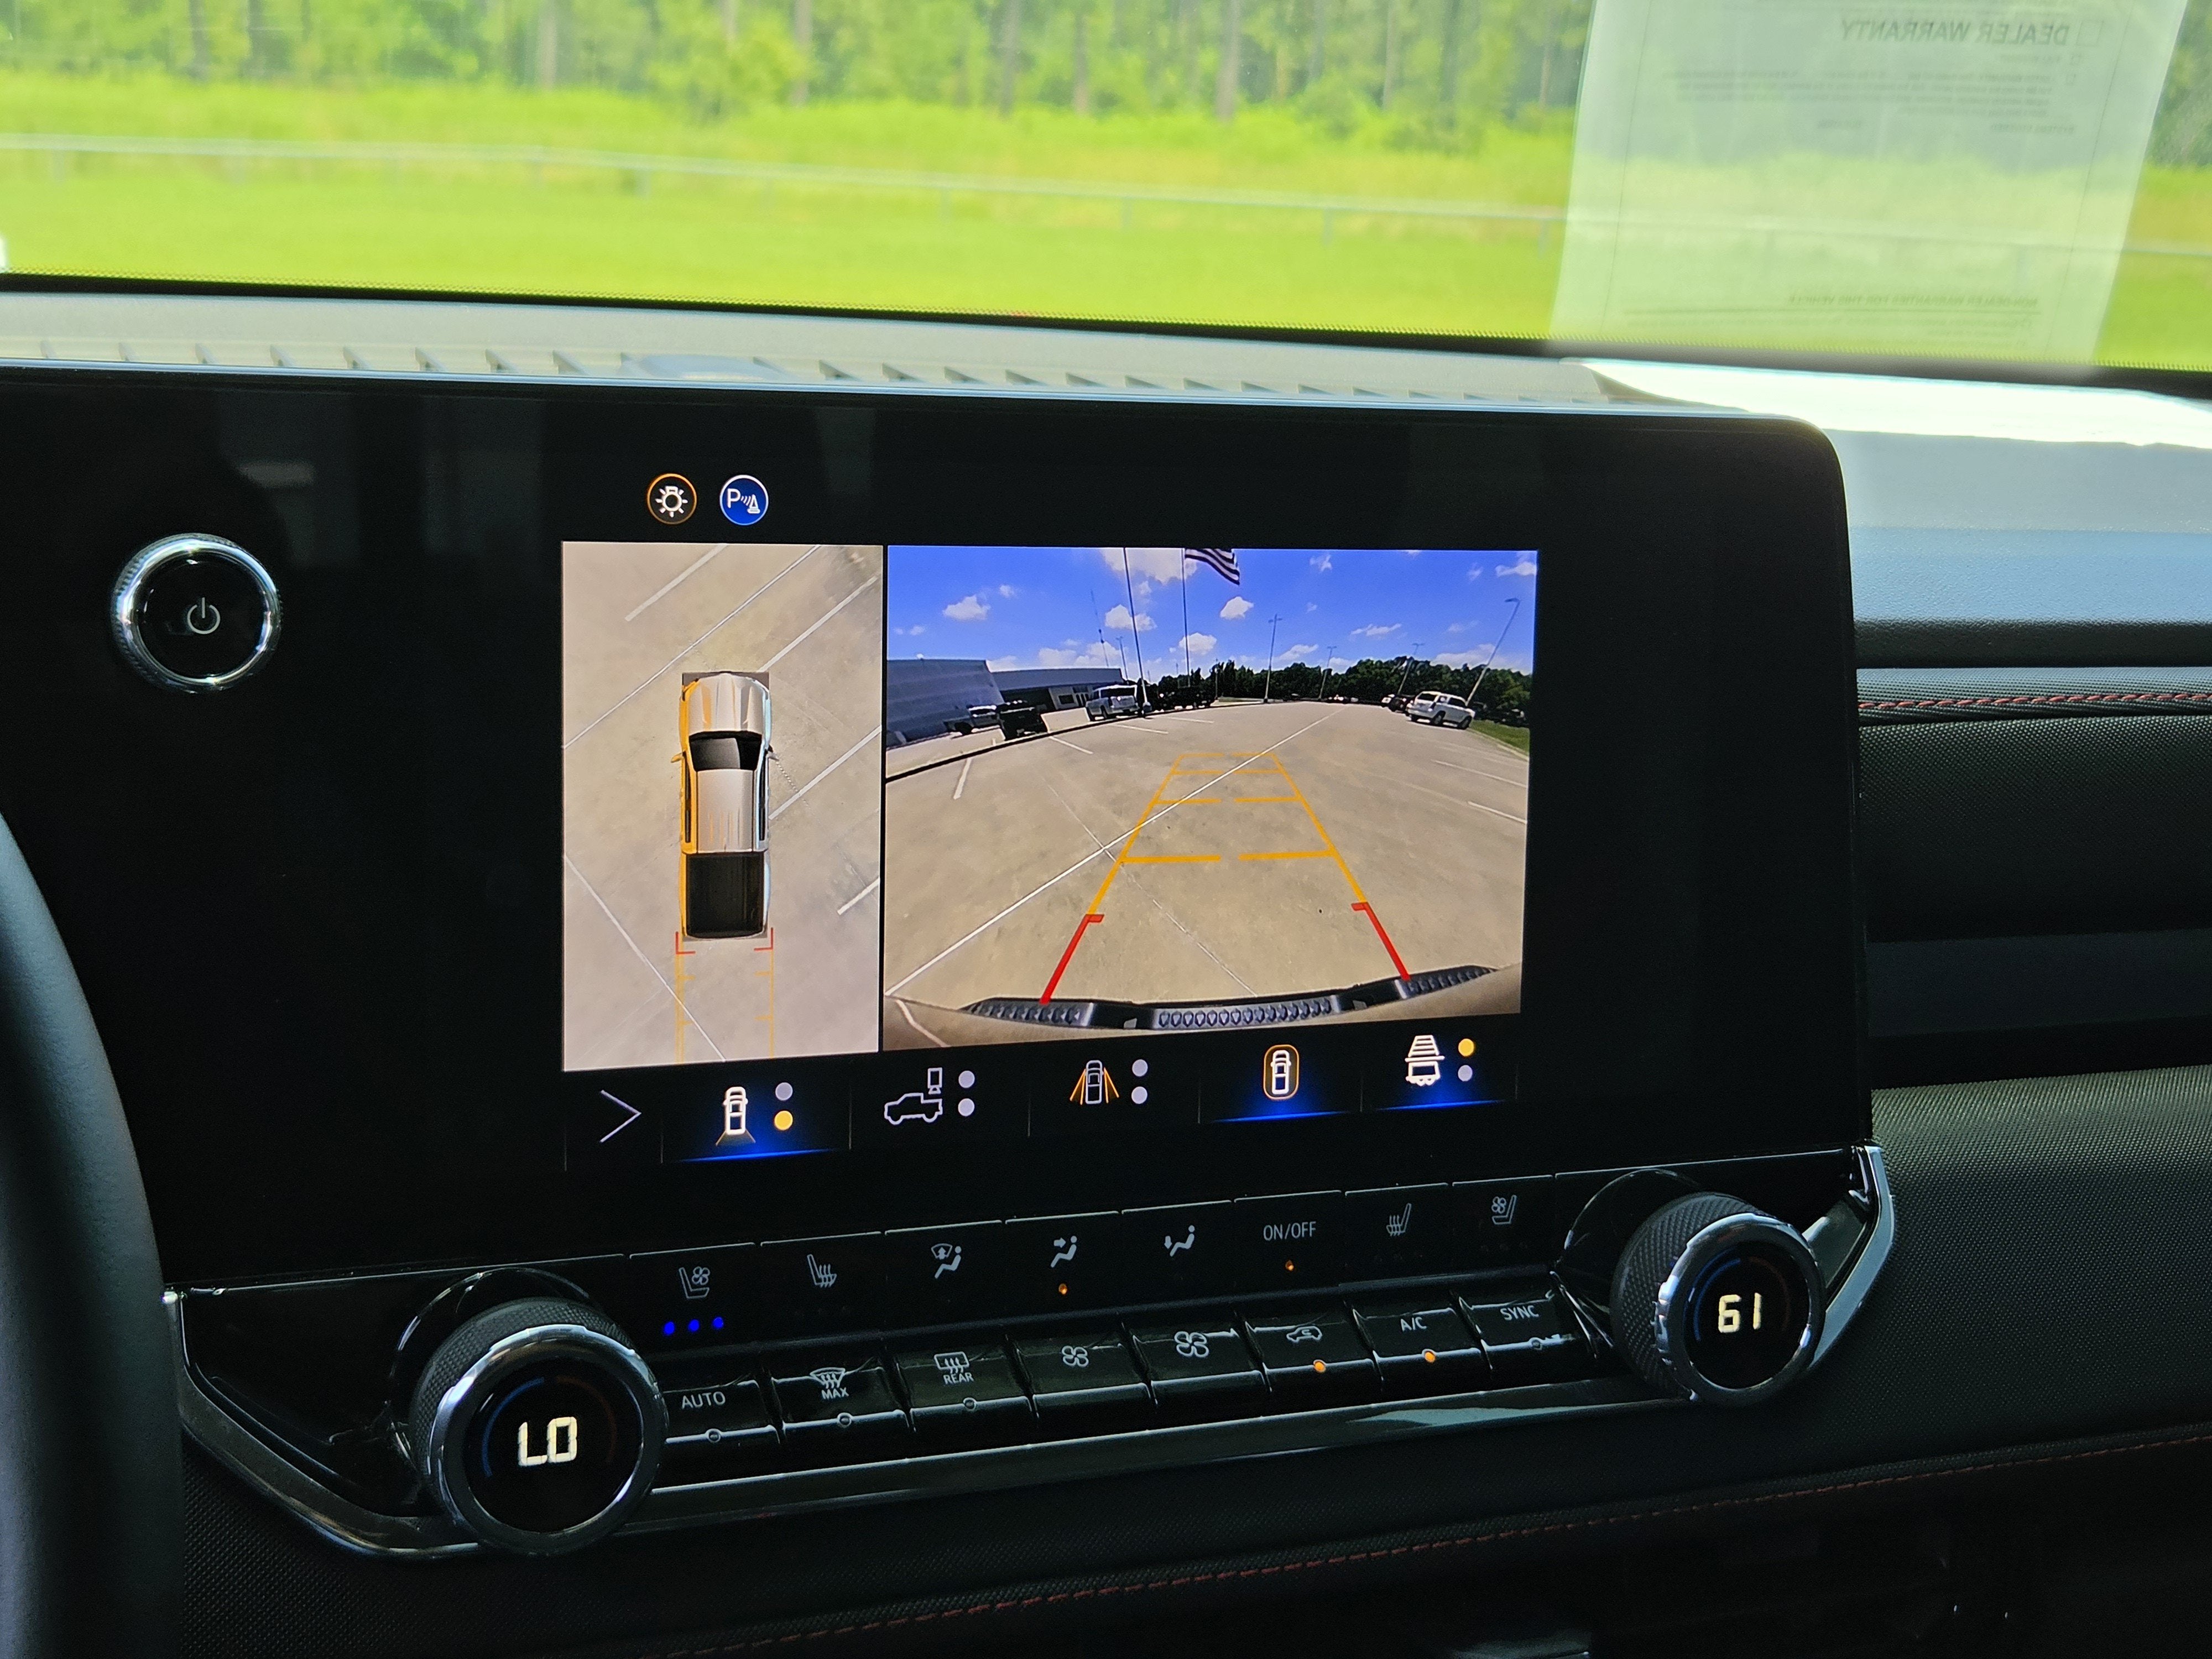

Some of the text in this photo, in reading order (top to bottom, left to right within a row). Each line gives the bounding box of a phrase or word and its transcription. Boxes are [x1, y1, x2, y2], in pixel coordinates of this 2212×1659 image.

[1263, 1220, 1317, 1241] ON/OFF
[1500, 1304, 1540, 1321] SYNC
[1718, 1292, 1762, 1334] 61
[1400, 1316, 1426, 1332] A/C
[943, 1370, 974, 1385] REAR
[681, 1391, 726, 1410] AUTO
[821, 1387, 849, 1400] MAX
